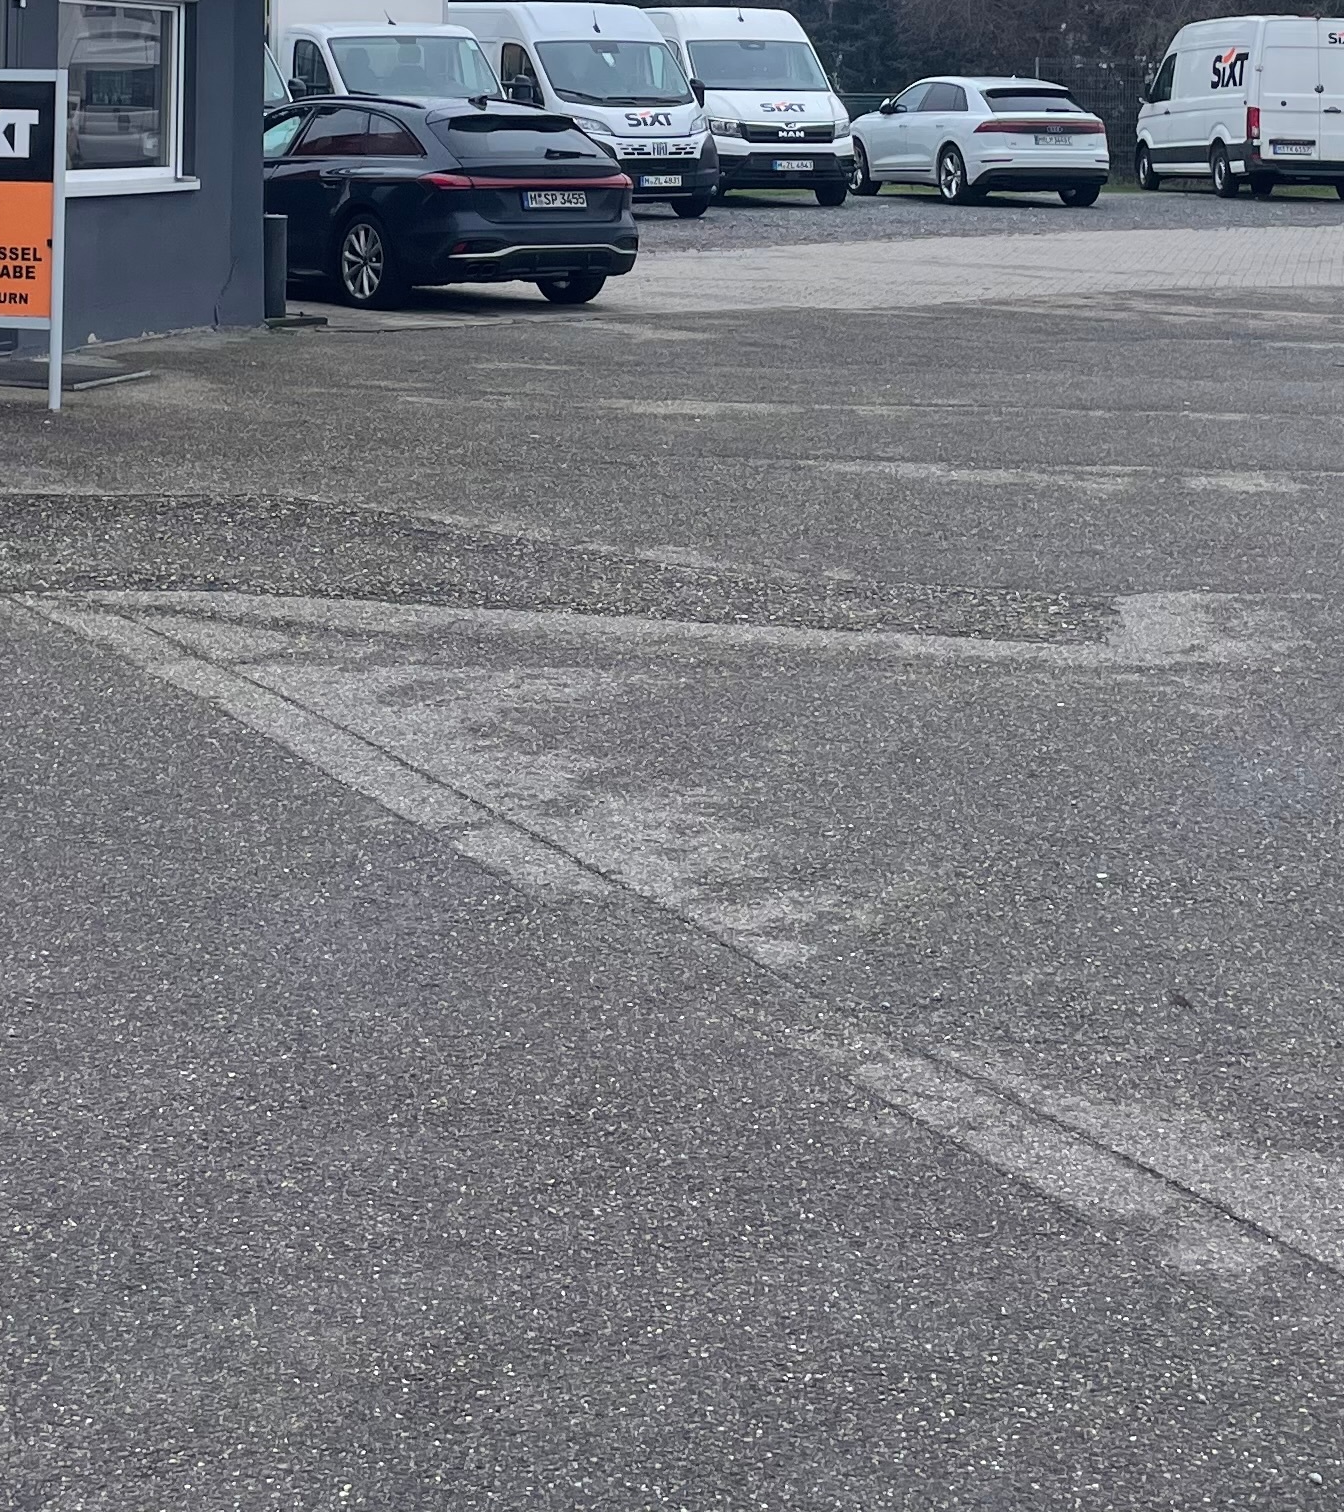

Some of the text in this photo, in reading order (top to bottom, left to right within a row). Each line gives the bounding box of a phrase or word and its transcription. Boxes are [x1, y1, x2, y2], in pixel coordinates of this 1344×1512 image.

[778, 130, 805, 138] MAN
[544, 192, 557, 205] SP
[560, 192, 585, 205] 3455
